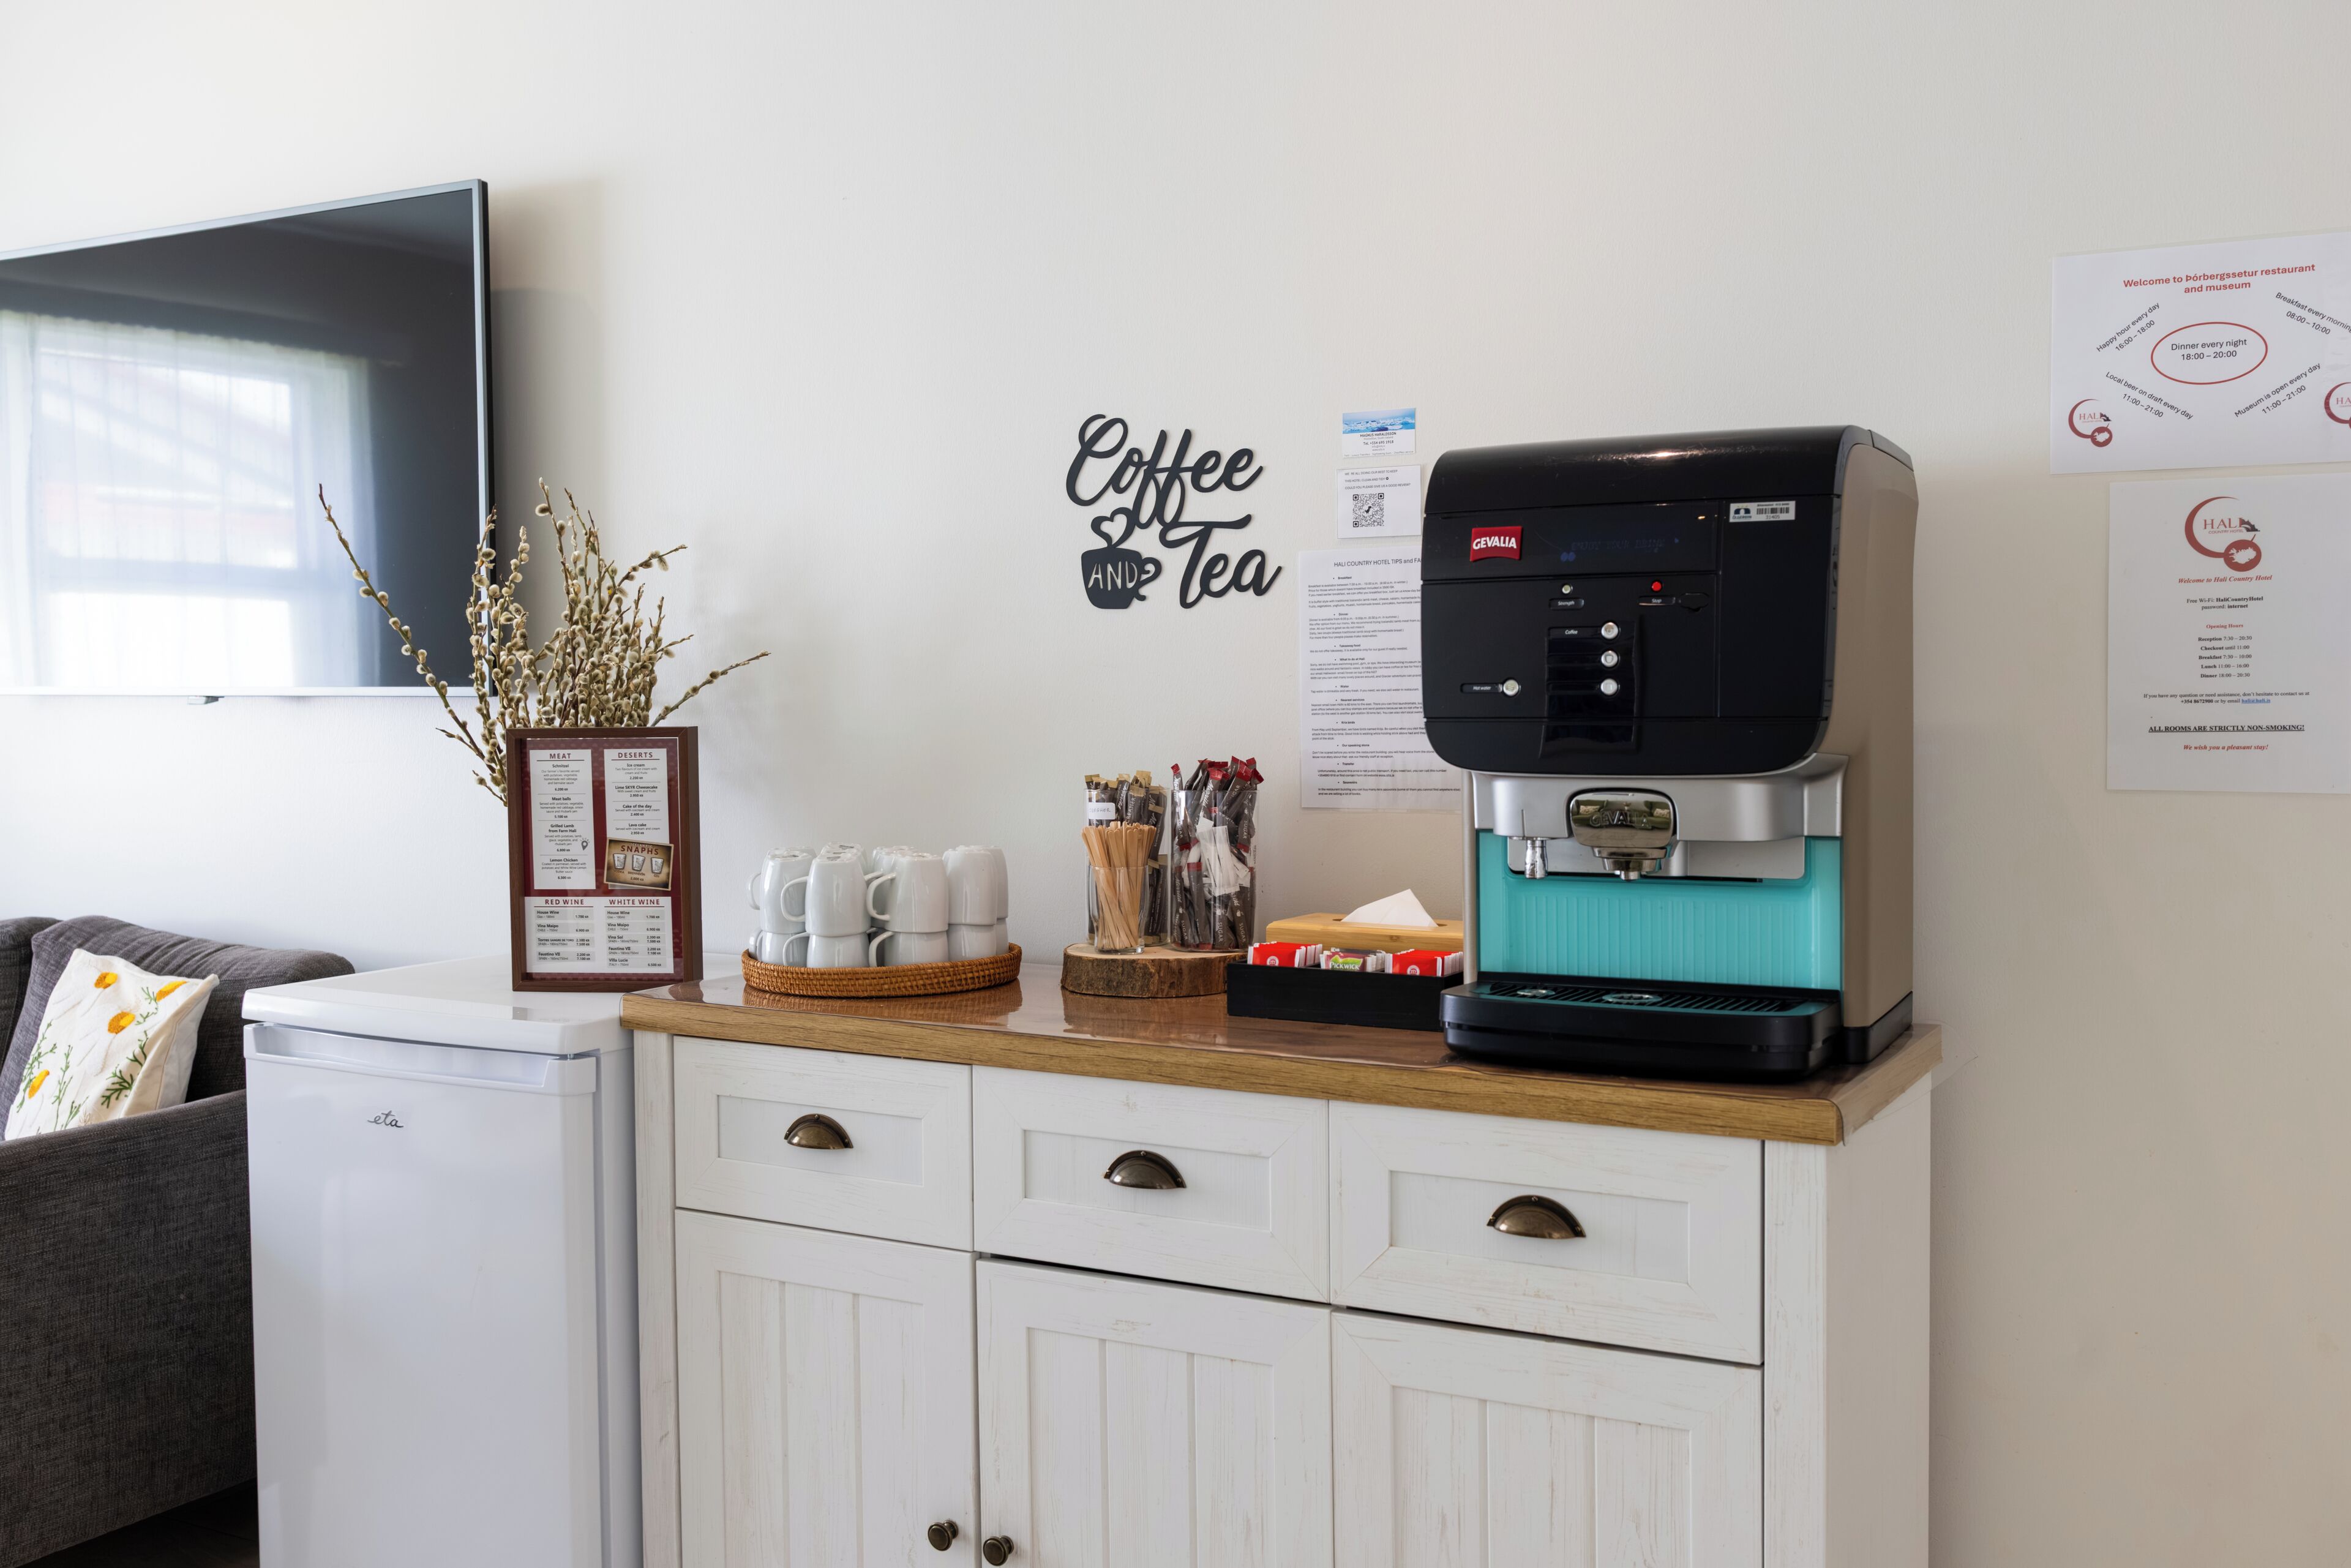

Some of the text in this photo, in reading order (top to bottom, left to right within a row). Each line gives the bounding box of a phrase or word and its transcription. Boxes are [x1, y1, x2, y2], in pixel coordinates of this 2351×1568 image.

[2123, 277, 2170, 287] Welcome
[2185, 270, 2259, 282] Þórbergssetur
[2260, 264, 2315, 276] restaurant
[2184, 282, 2251, 293] and museum
[2275, 292, 2308, 311] Breakfast
[2307, 307, 2327, 320] every
[2096, 302, 2159, 352] Happy hour every day
[2286, 310, 2331, 334] 08:00 10:00
[2115, 320, 2155, 351] 16:00 18:00
[2225, 339, 2247, 348] night
[2181, 350, 2237, 361] 18:00 20:00
[2105, 372, 2124, 384] Local
[2123, 380, 2139, 391] beer
[2147, 393, 2163, 404] draft
[2162, 401, 2181, 414] every
[2180, 410, 2194, 420] day
[2234, 397, 2265, 418] Museum
[2271, 383, 2289, 396] open
[2289, 371, 2307, 384] every
[2308, 363, 2320, 373] day
[2262, 385, 2306, 415] 11:00 21:00
[2122, 393, 2164, 418] 11:00 21:00
[1066, 414, 1264, 529] Coffee
[2204, 517, 2243, 530] HALI
[1473, 536, 1517, 550] GEVALIA
[1159, 513, 1283, 609] Tea
[1088, 560, 1139, 591] AND
[1590, 809, 1652, 829] GEVALIA
[621, 846, 659, 855] SNAPHS
[1330, 961, 1360, 970] PICKWICK
[367, 1109, 404, 1129] eta
